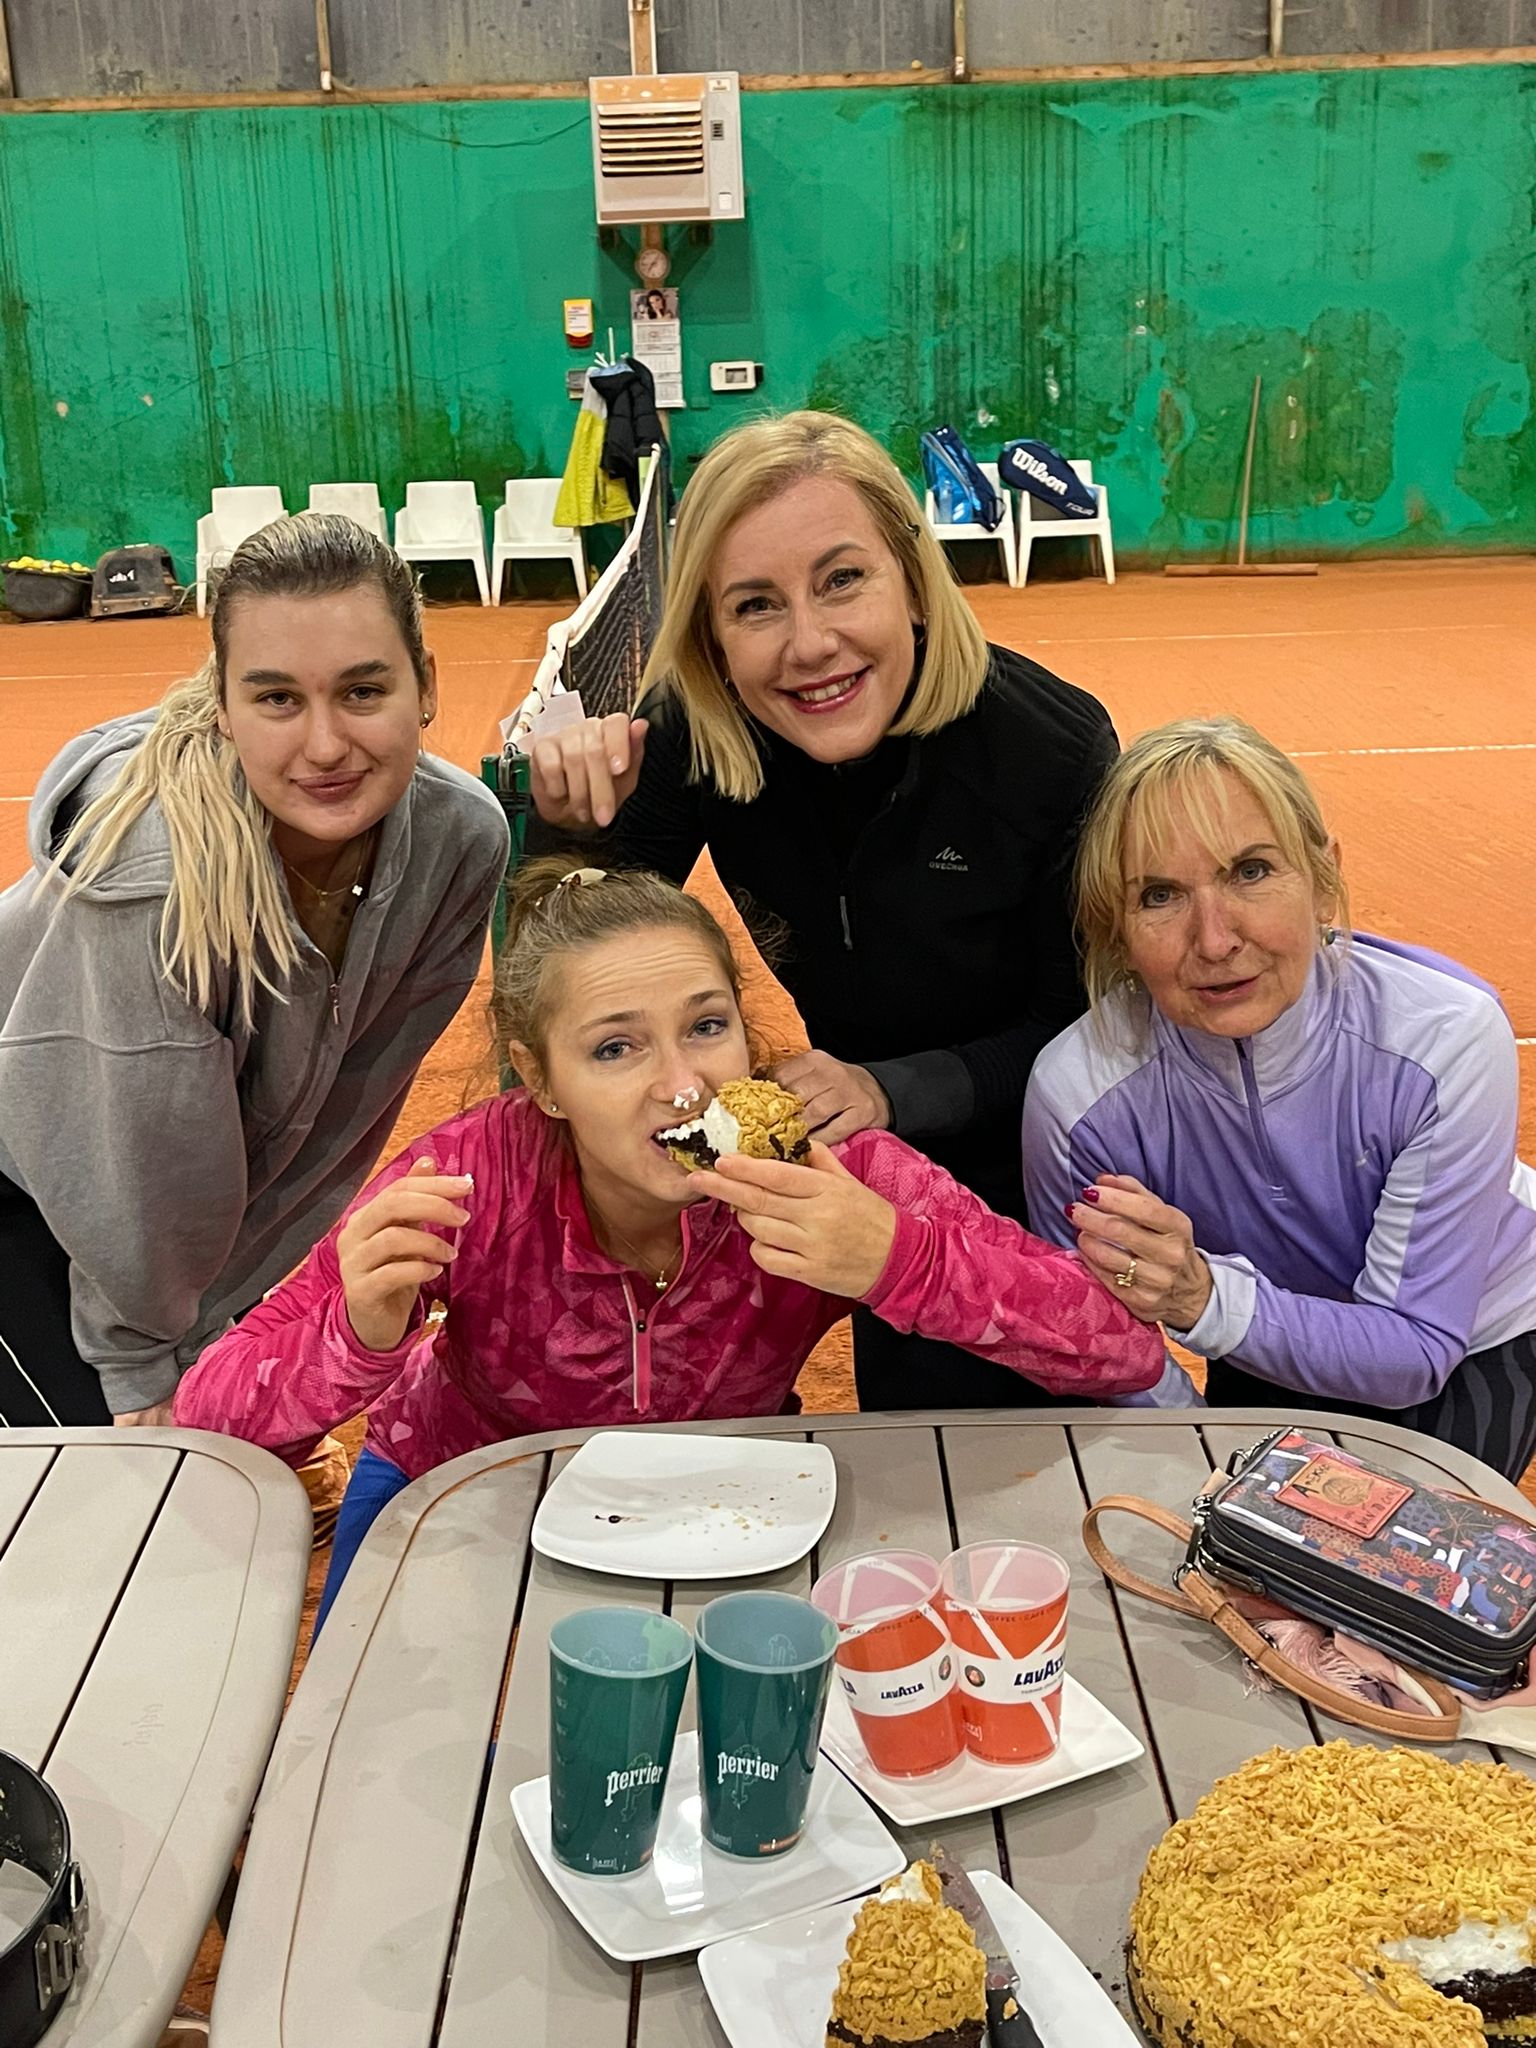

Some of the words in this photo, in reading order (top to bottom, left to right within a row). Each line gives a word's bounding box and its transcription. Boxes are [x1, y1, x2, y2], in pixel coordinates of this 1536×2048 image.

[1011, 447, 1069, 496] Wilson
[1065, 501, 1095, 516] TOUR
[928, 861, 969, 872] QUECHUA
[880, 1683, 925, 1700] LAVAZZA
[717, 1751, 779, 1784] perrier
[604, 1762, 664, 1807] perrier
